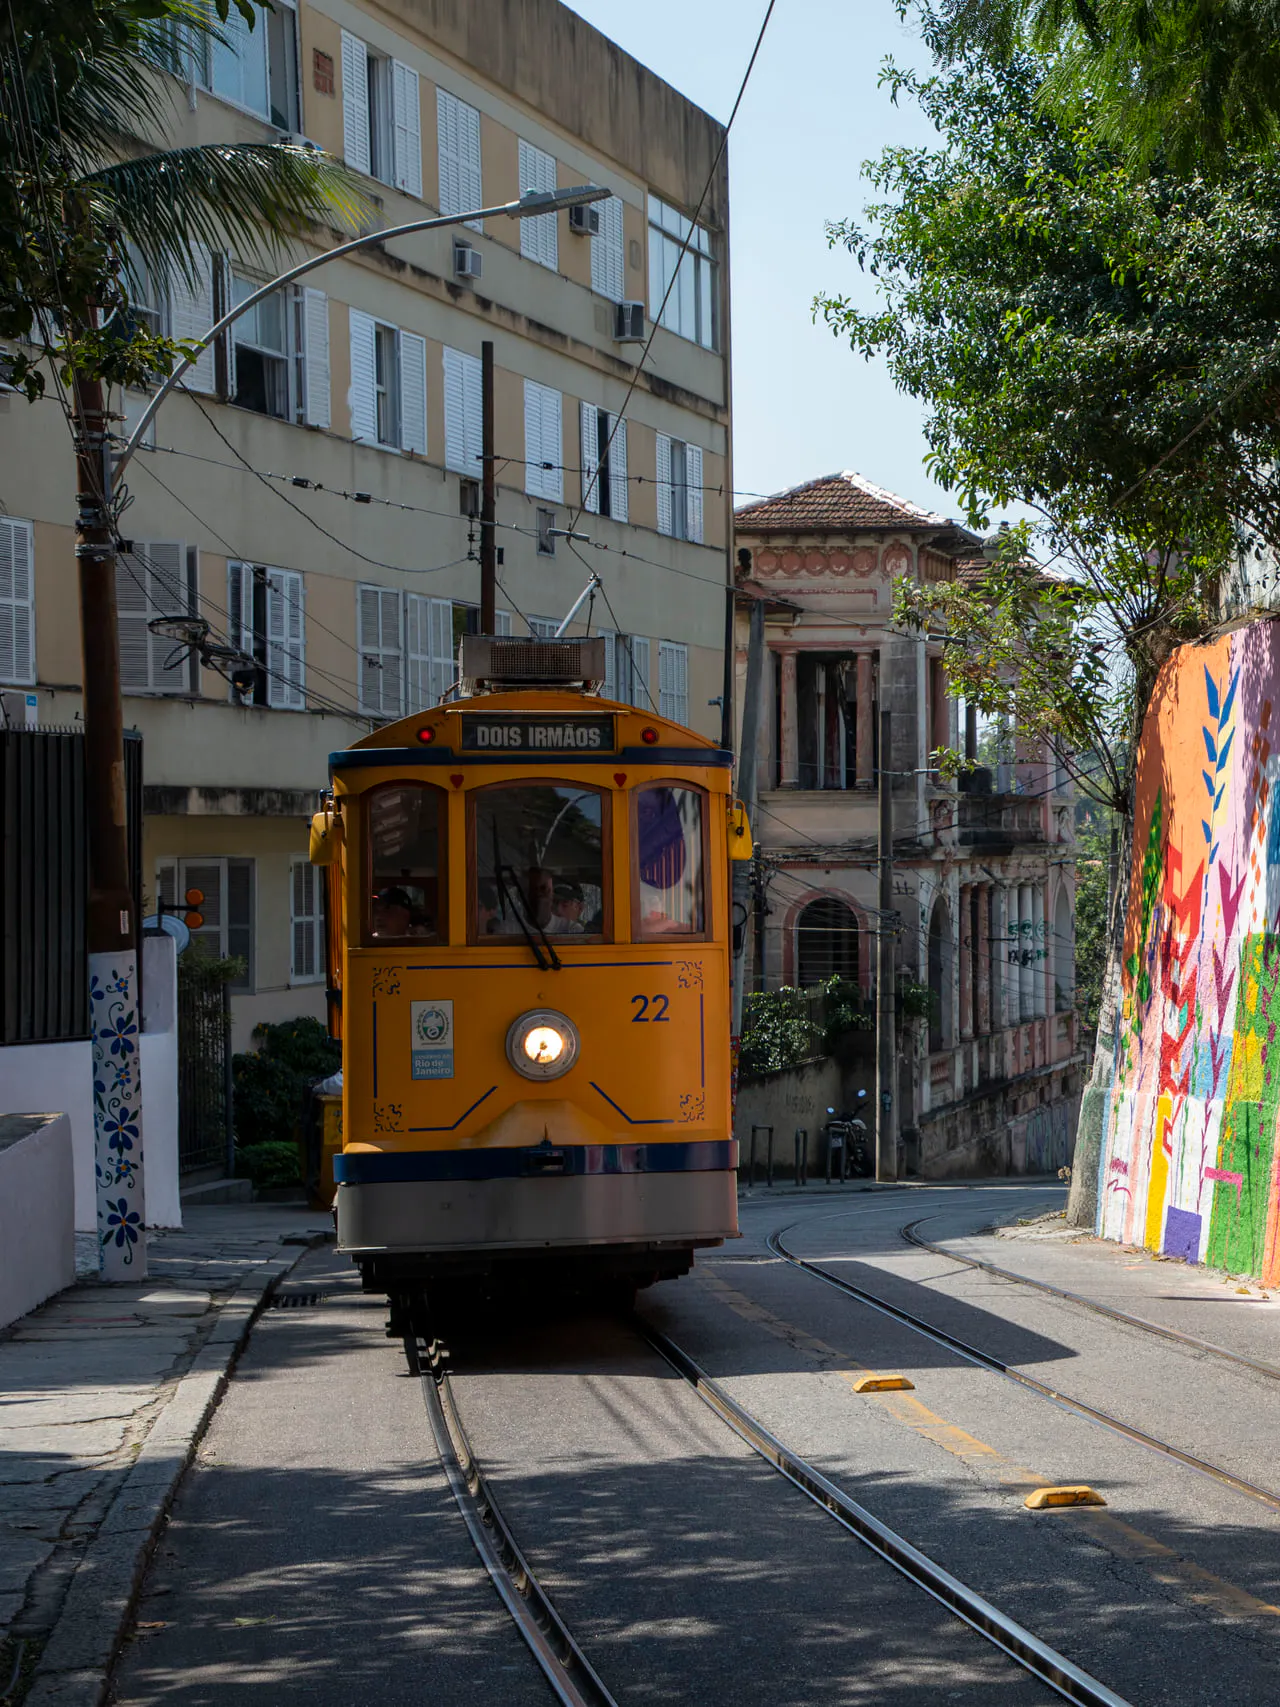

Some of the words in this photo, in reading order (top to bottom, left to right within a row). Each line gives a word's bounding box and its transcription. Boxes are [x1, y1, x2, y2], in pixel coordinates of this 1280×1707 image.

[476, 726, 521, 747] DOIS
[528, 723, 601, 748] IRMÃOS
[631, 993, 670, 1023] 22
[415, 1059, 430, 1067] Rio
[431, 1059, 444, 1067] de
[415, 1067, 451, 1075] Janeiro
